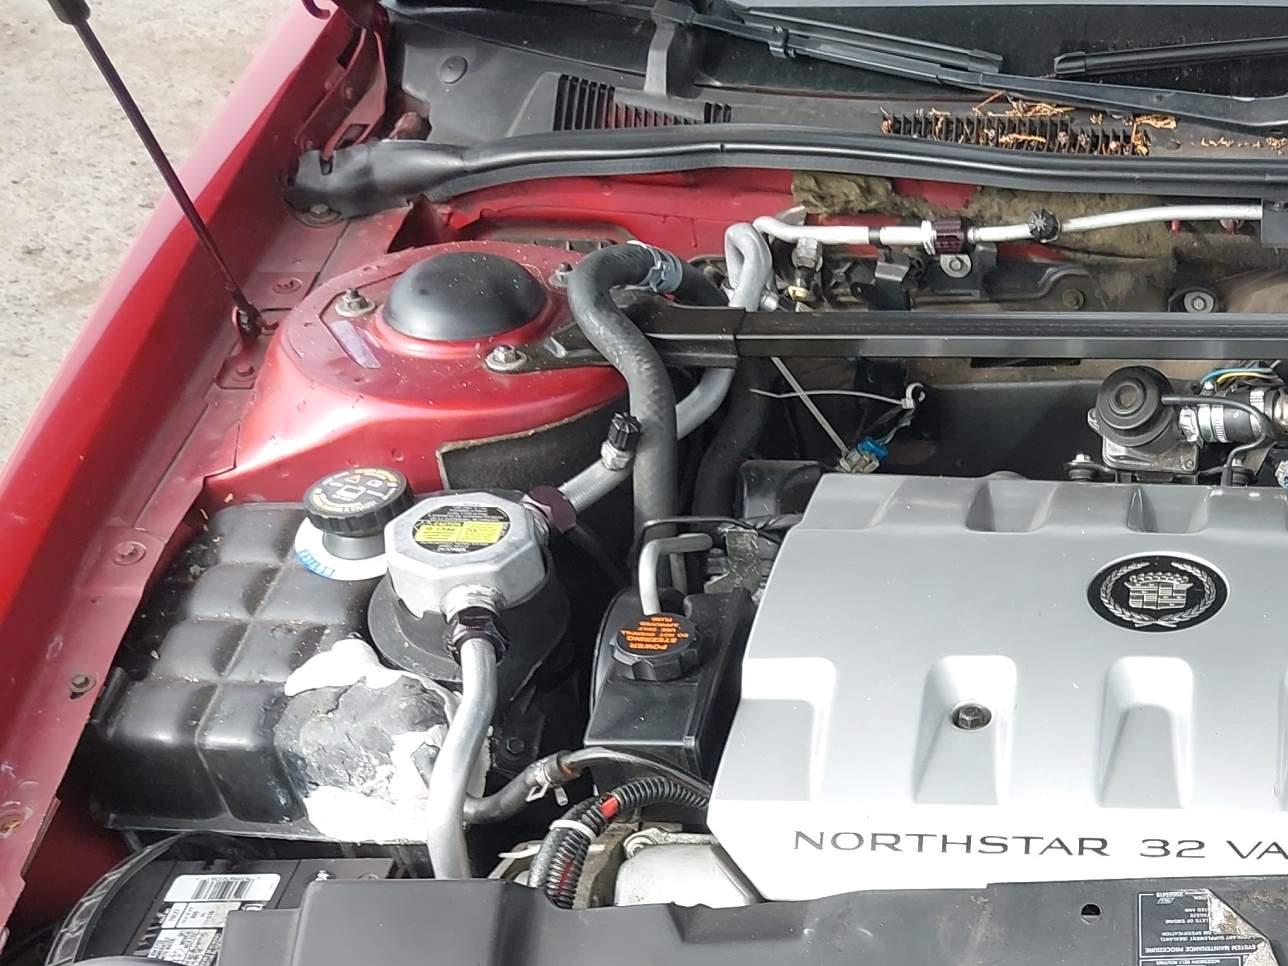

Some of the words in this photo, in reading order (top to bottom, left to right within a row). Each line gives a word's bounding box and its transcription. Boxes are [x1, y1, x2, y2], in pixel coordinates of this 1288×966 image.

[626, 635, 678, 644] STEERING
[628, 642, 668, 650] POWER
[794, 830, 1110, 857] NORTHSTAR
[1140, 838, 1206, 859] 32
[1143, 946, 1184, 954] PROCEDURE
[1185, 944, 1230, 953] MAINTENANCE
[1230, 944, 1257, 952] SYSTEM
